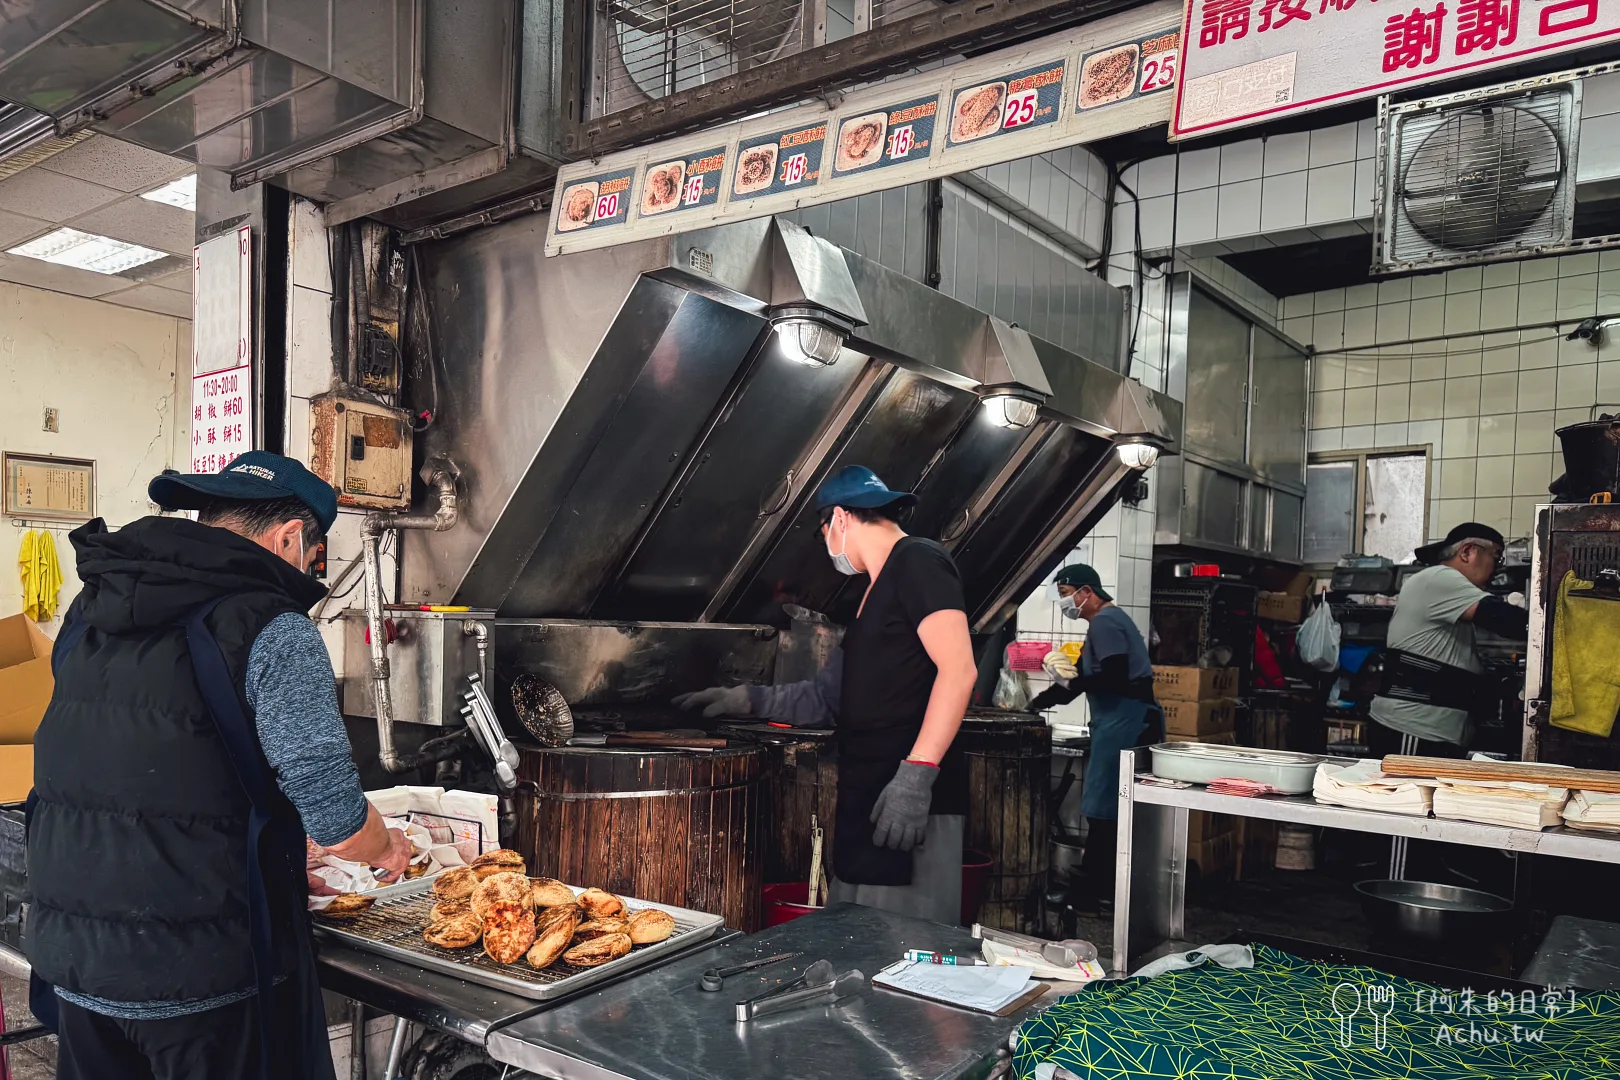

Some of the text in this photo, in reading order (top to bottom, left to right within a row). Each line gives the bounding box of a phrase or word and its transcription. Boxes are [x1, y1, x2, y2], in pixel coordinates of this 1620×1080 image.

[1199, 0, 1356, 48] 請按
[1141, 55, 1176, 91] 25
[889, 101, 937, 125] 綠豆酥餅
[1004, 94, 1036, 128] 25
[779, 124, 828, 149] 紅豆酥餅
[894, 128, 910, 155] 15
[685, 155, 725, 177] 小酥餅
[788, 161, 802, 183] 15
[688, 178, 702, 203] 15
[597, 194, 618, 219] 60
[248, 465, 275, 476] NATURAL
[248, 469, 273, 481] HIKER
